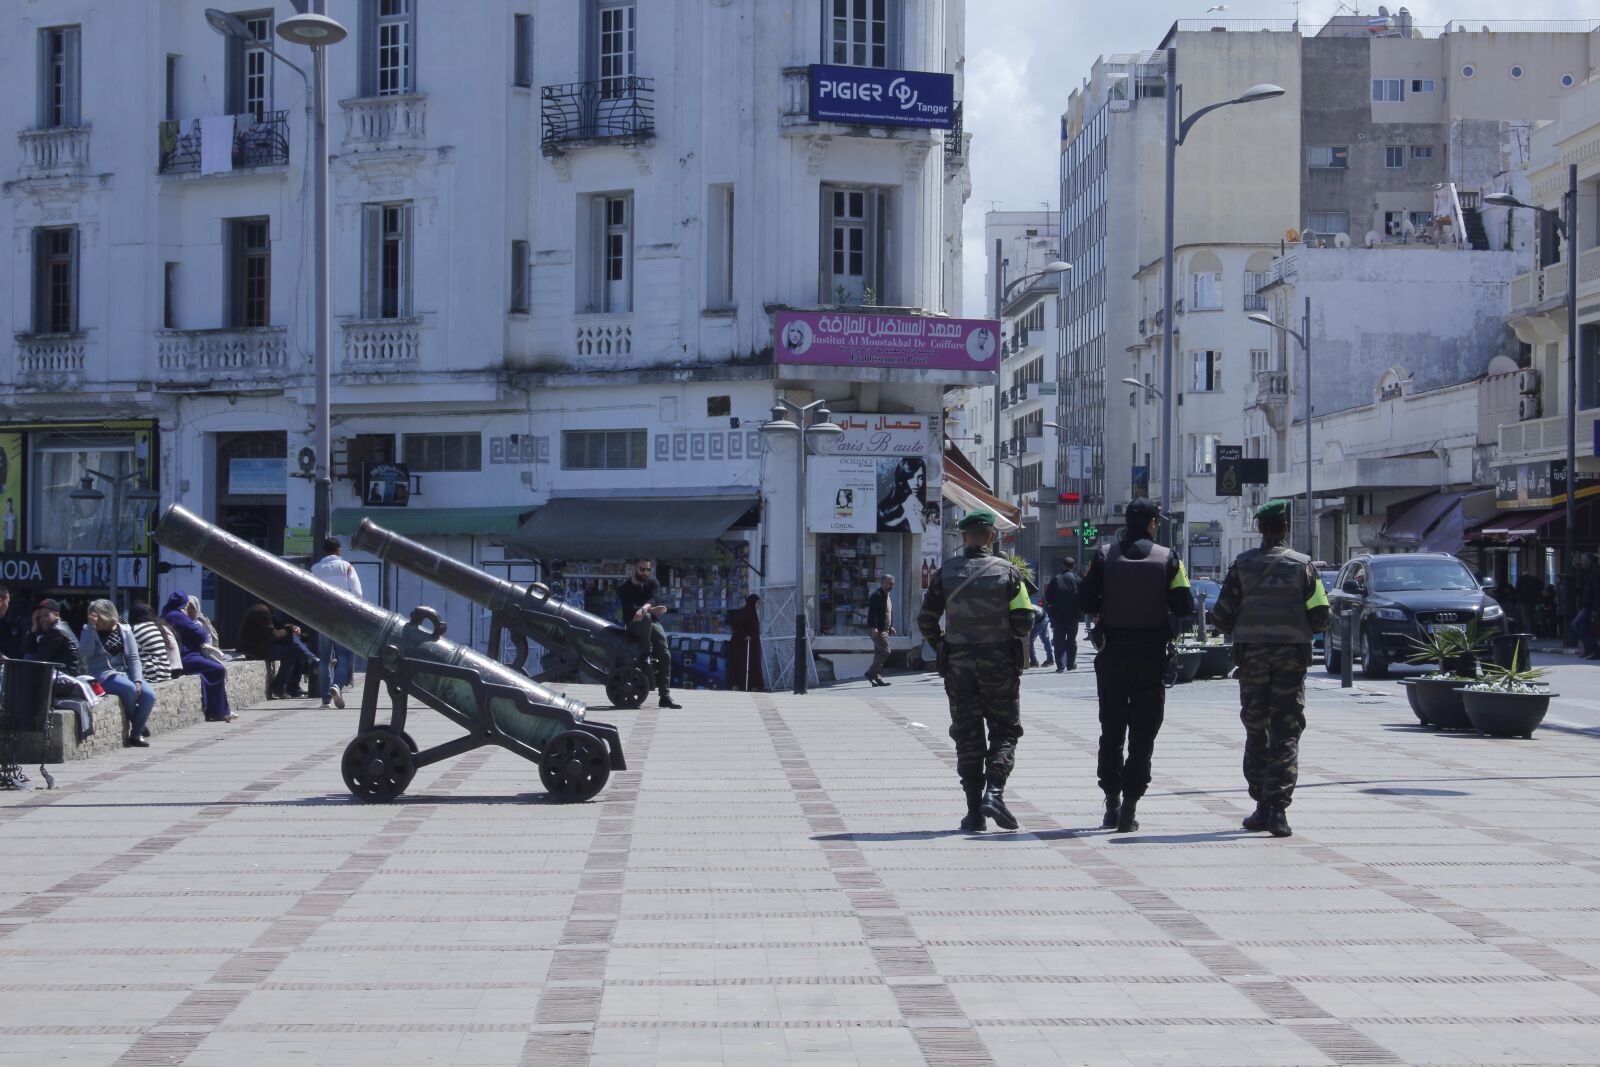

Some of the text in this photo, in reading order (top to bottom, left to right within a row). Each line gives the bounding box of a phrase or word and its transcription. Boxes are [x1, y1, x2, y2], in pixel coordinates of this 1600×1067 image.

[820, 80, 883, 102] PIGIER
[917, 102, 949, 115] Tanger
[818, 315, 962, 338] معهد المستقبل للحلاقة
[812, 334, 846, 345] Institut
[849, 336, 858, 346] Al
[861, 336, 912, 348] Moustakbal
[914, 338, 926, 349] De
[930, 339, 966, 350] Coiffure
[874, 415, 922, 432] جمال
